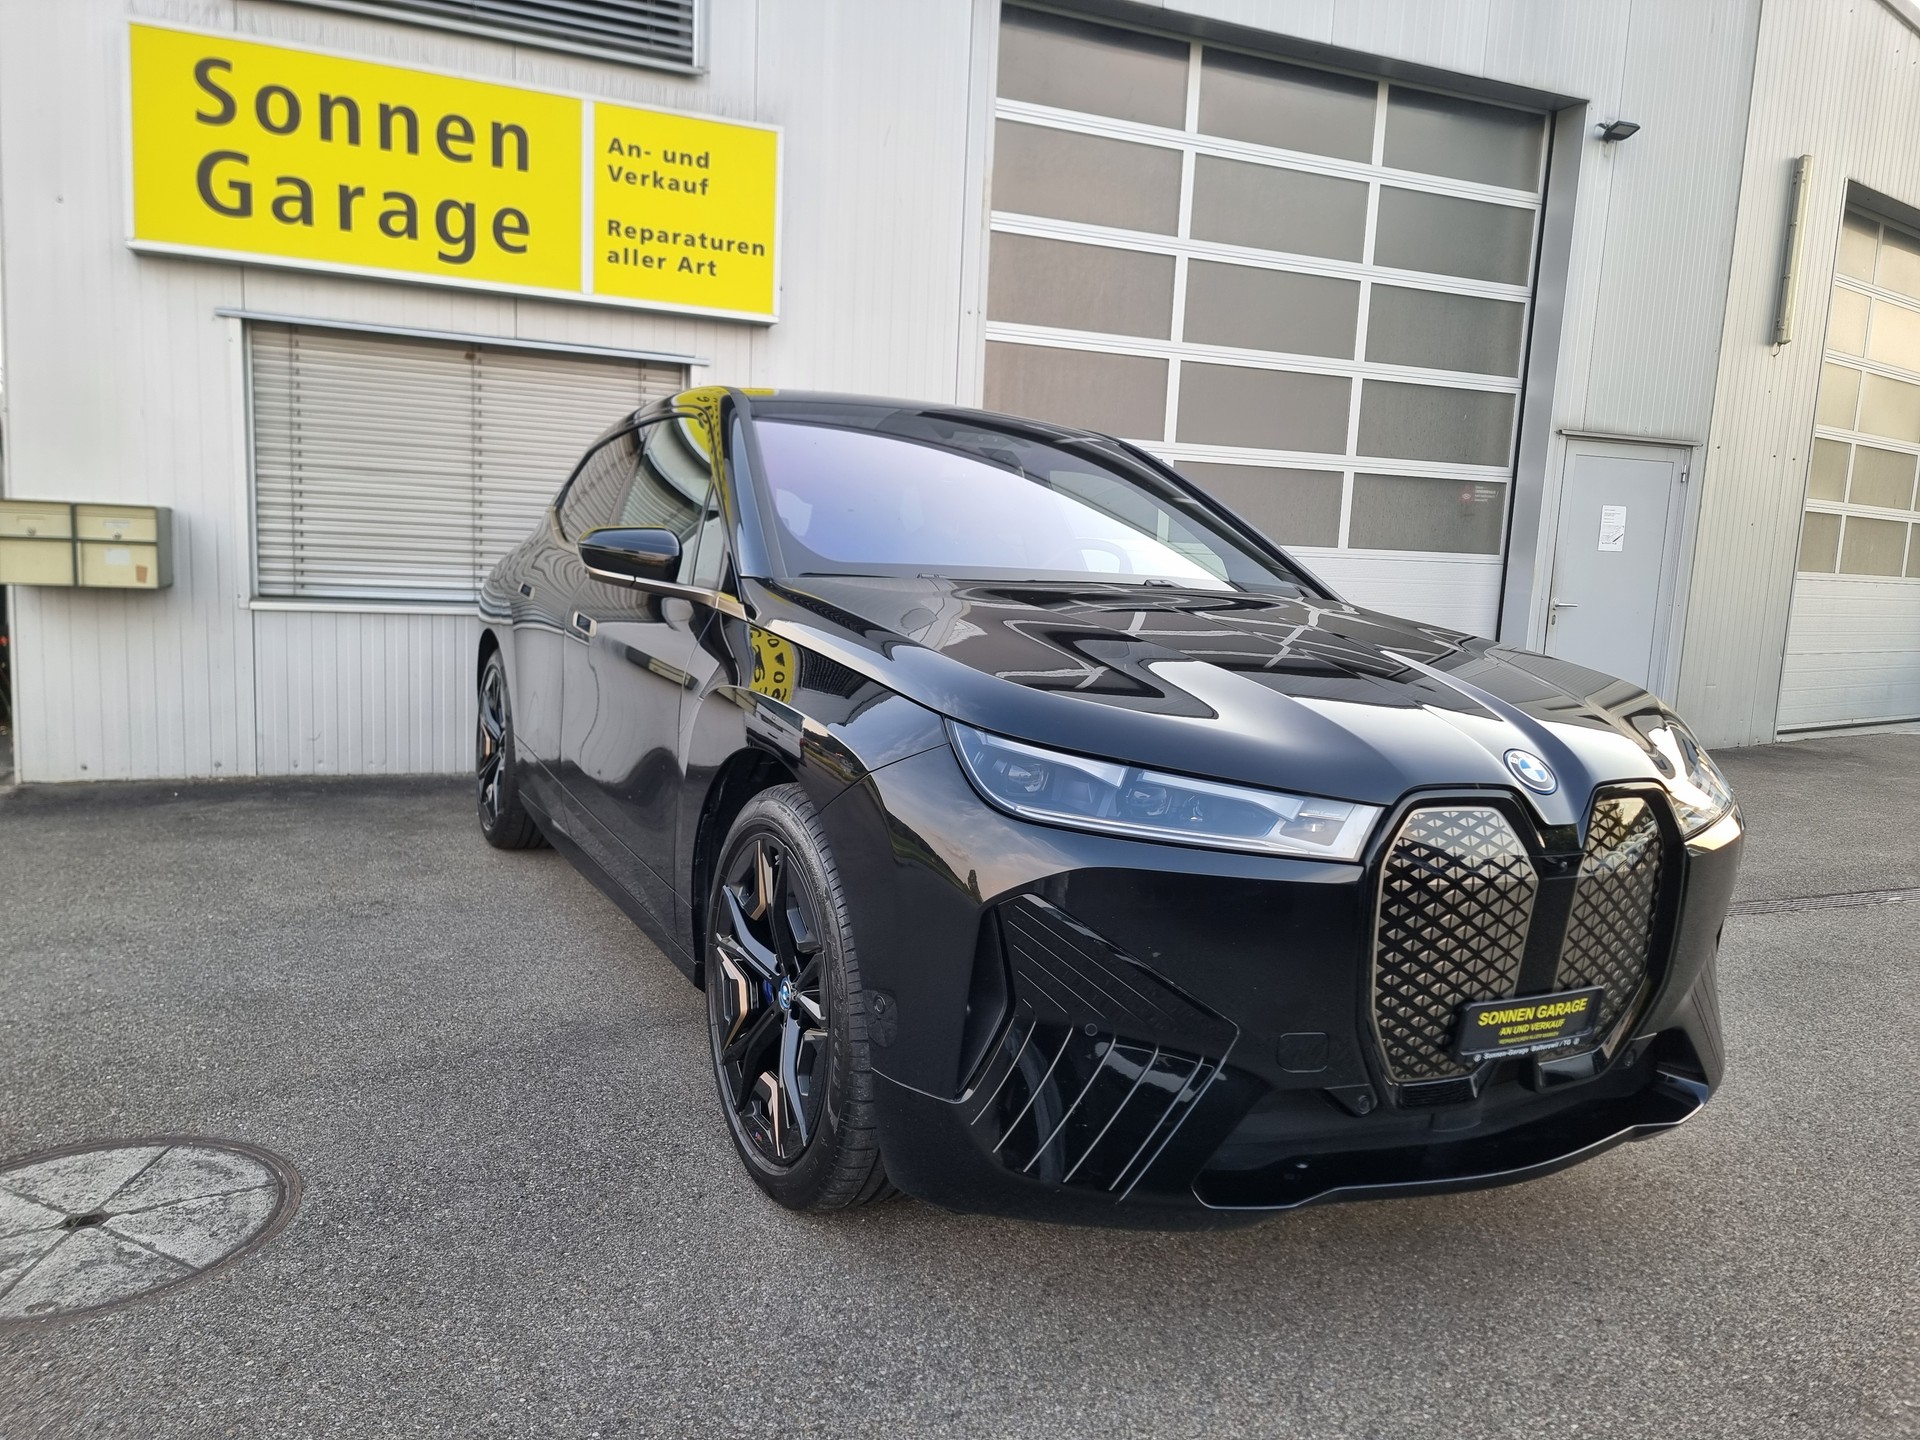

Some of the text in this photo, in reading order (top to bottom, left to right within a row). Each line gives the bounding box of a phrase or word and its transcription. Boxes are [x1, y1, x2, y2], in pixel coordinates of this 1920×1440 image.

[194, 57, 529, 172] Sonnen
[607, 137, 710, 169] An- und
[607, 164, 709, 196] Verkauf
[196, 150, 530, 265] Garage
[607, 219, 766, 257] Reparaturen
[607, 247, 717, 277] aller Art
[1478, 998, 1588, 1026] SONNEN GARAGE
[1513, 1024, 1530, 1034] UND
[1531, 1019, 1566, 1031] VERKAUF
